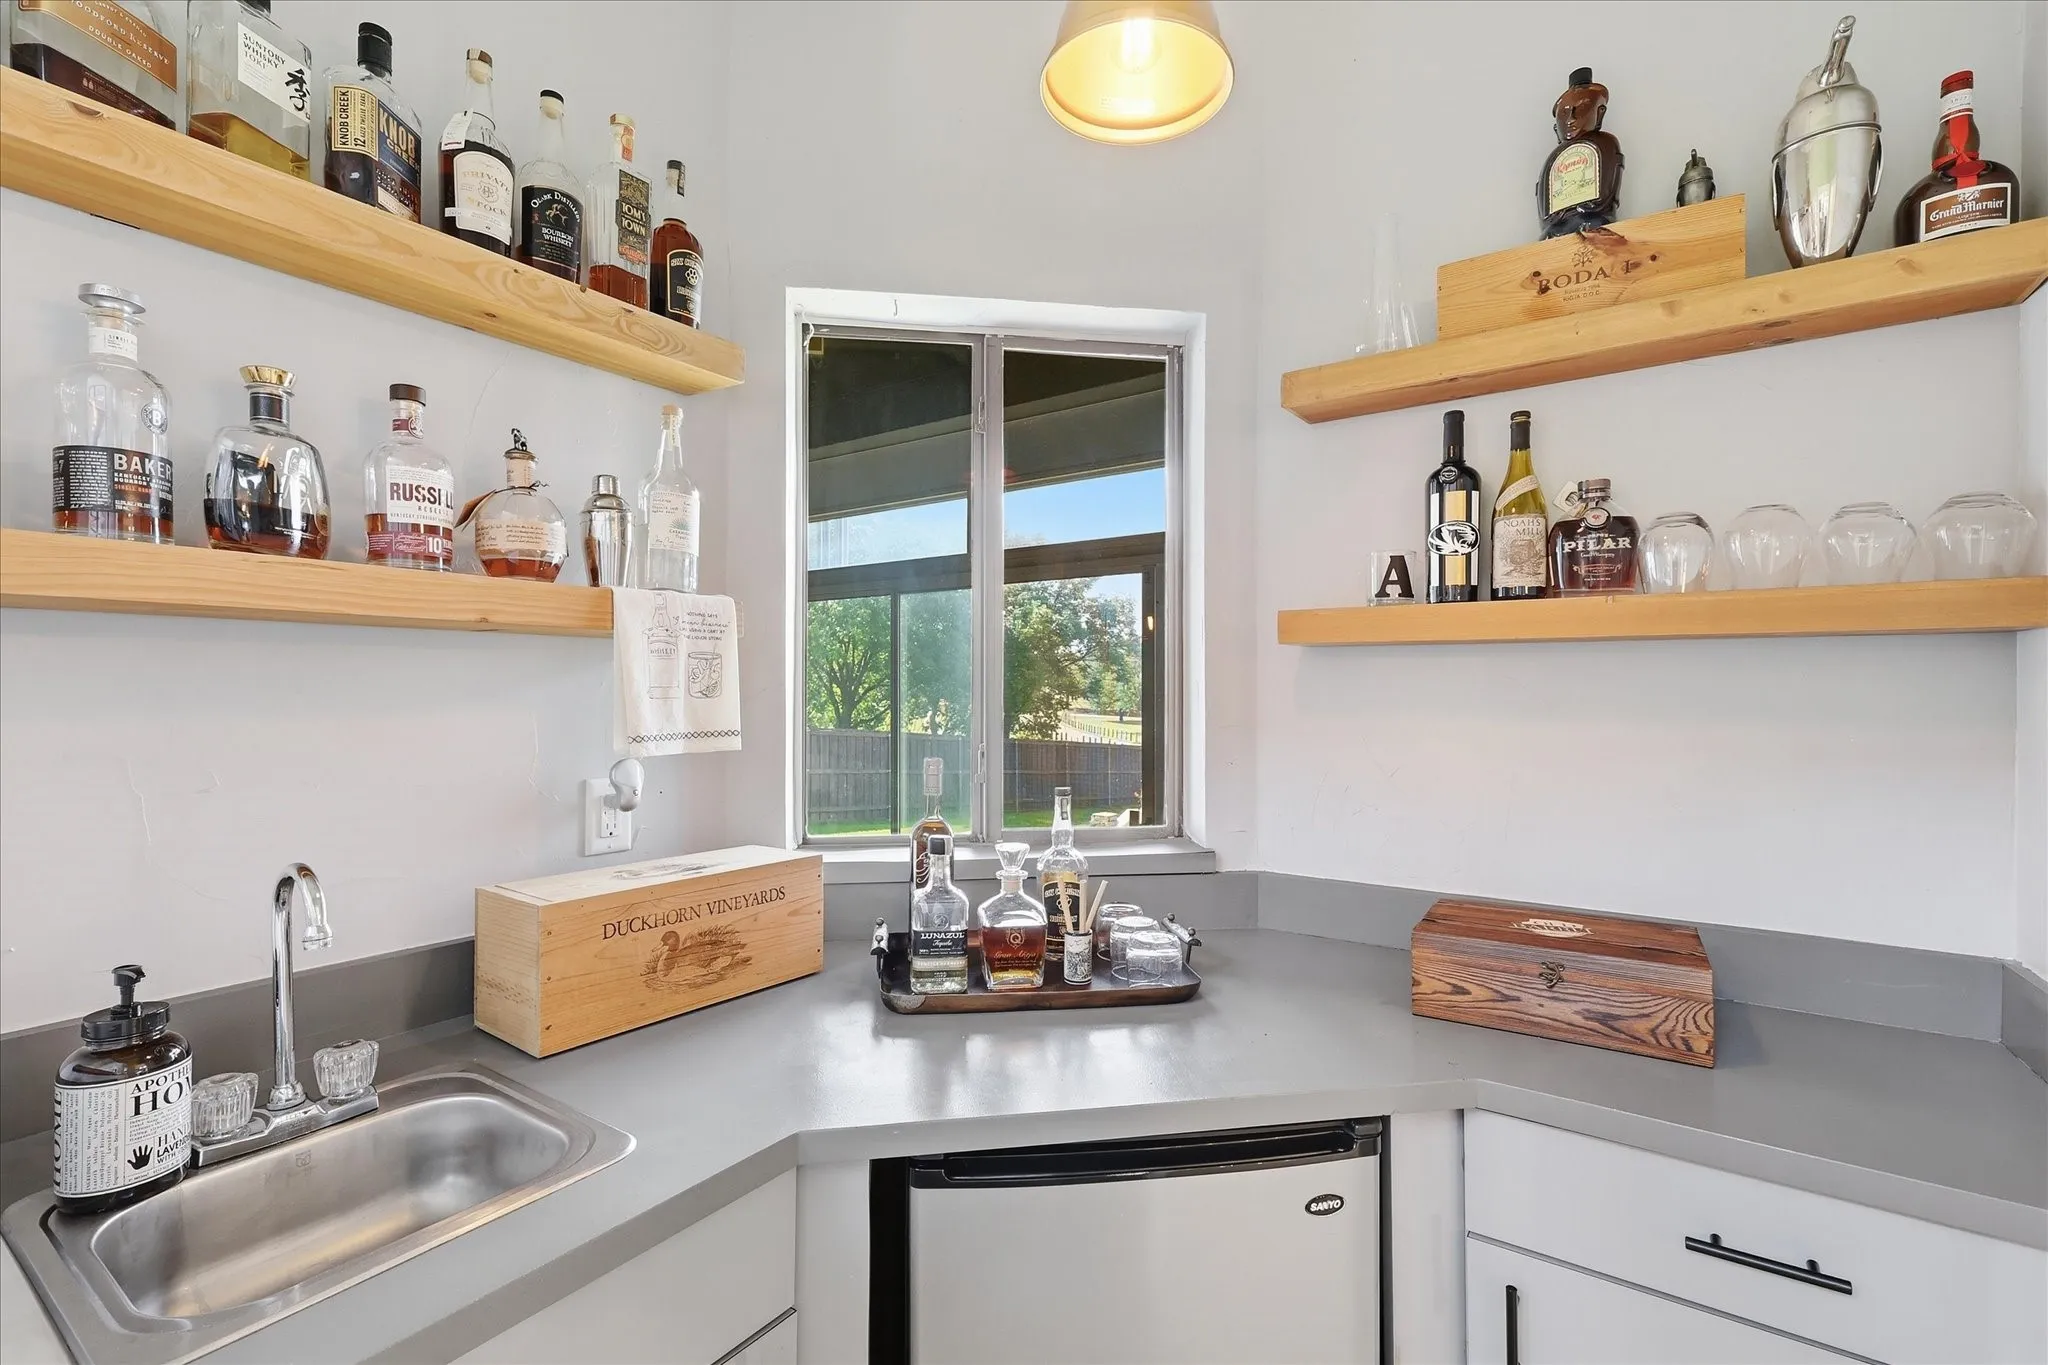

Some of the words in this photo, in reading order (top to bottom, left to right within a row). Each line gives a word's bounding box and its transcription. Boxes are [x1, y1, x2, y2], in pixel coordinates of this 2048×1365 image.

[88, 25, 122, 50] DOUBLE
[126, 48, 152, 69] OAKED
[243, 32, 286, 65] SUNTORY
[243, 41, 279, 69] WHISKY
[244, 50, 267, 70] TOKI
[339, 90, 349, 120] CREEK
[339, 121, 349, 146] KNOB
[353, 137, 366, 148] 12
[379, 107, 416, 159] KNOB
[1929, 202, 1962, 222] Grand
[1961, 198, 2005, 214] Marnier
[541, 227, 574, 243] BOURBON
[621, 216, 646, 237] TOWN
[543, 233, 573, 248] WHISKEY
[1537, 266, 1611, 296] RODA
[427, 536, 442, 554] 10
[1562, 536, 1633, 554] PILAR
[1375, 555, 1415, 598] A
[601, 904, 701, 940] DUCKHORN
[706, 886, 786, 916] VINEYARDS
[920, 932, 965, 940] LUNAZUL
[157, 1152, 176, 1164] WITH
[1309, 1199, 1342, 1212] SANYO
